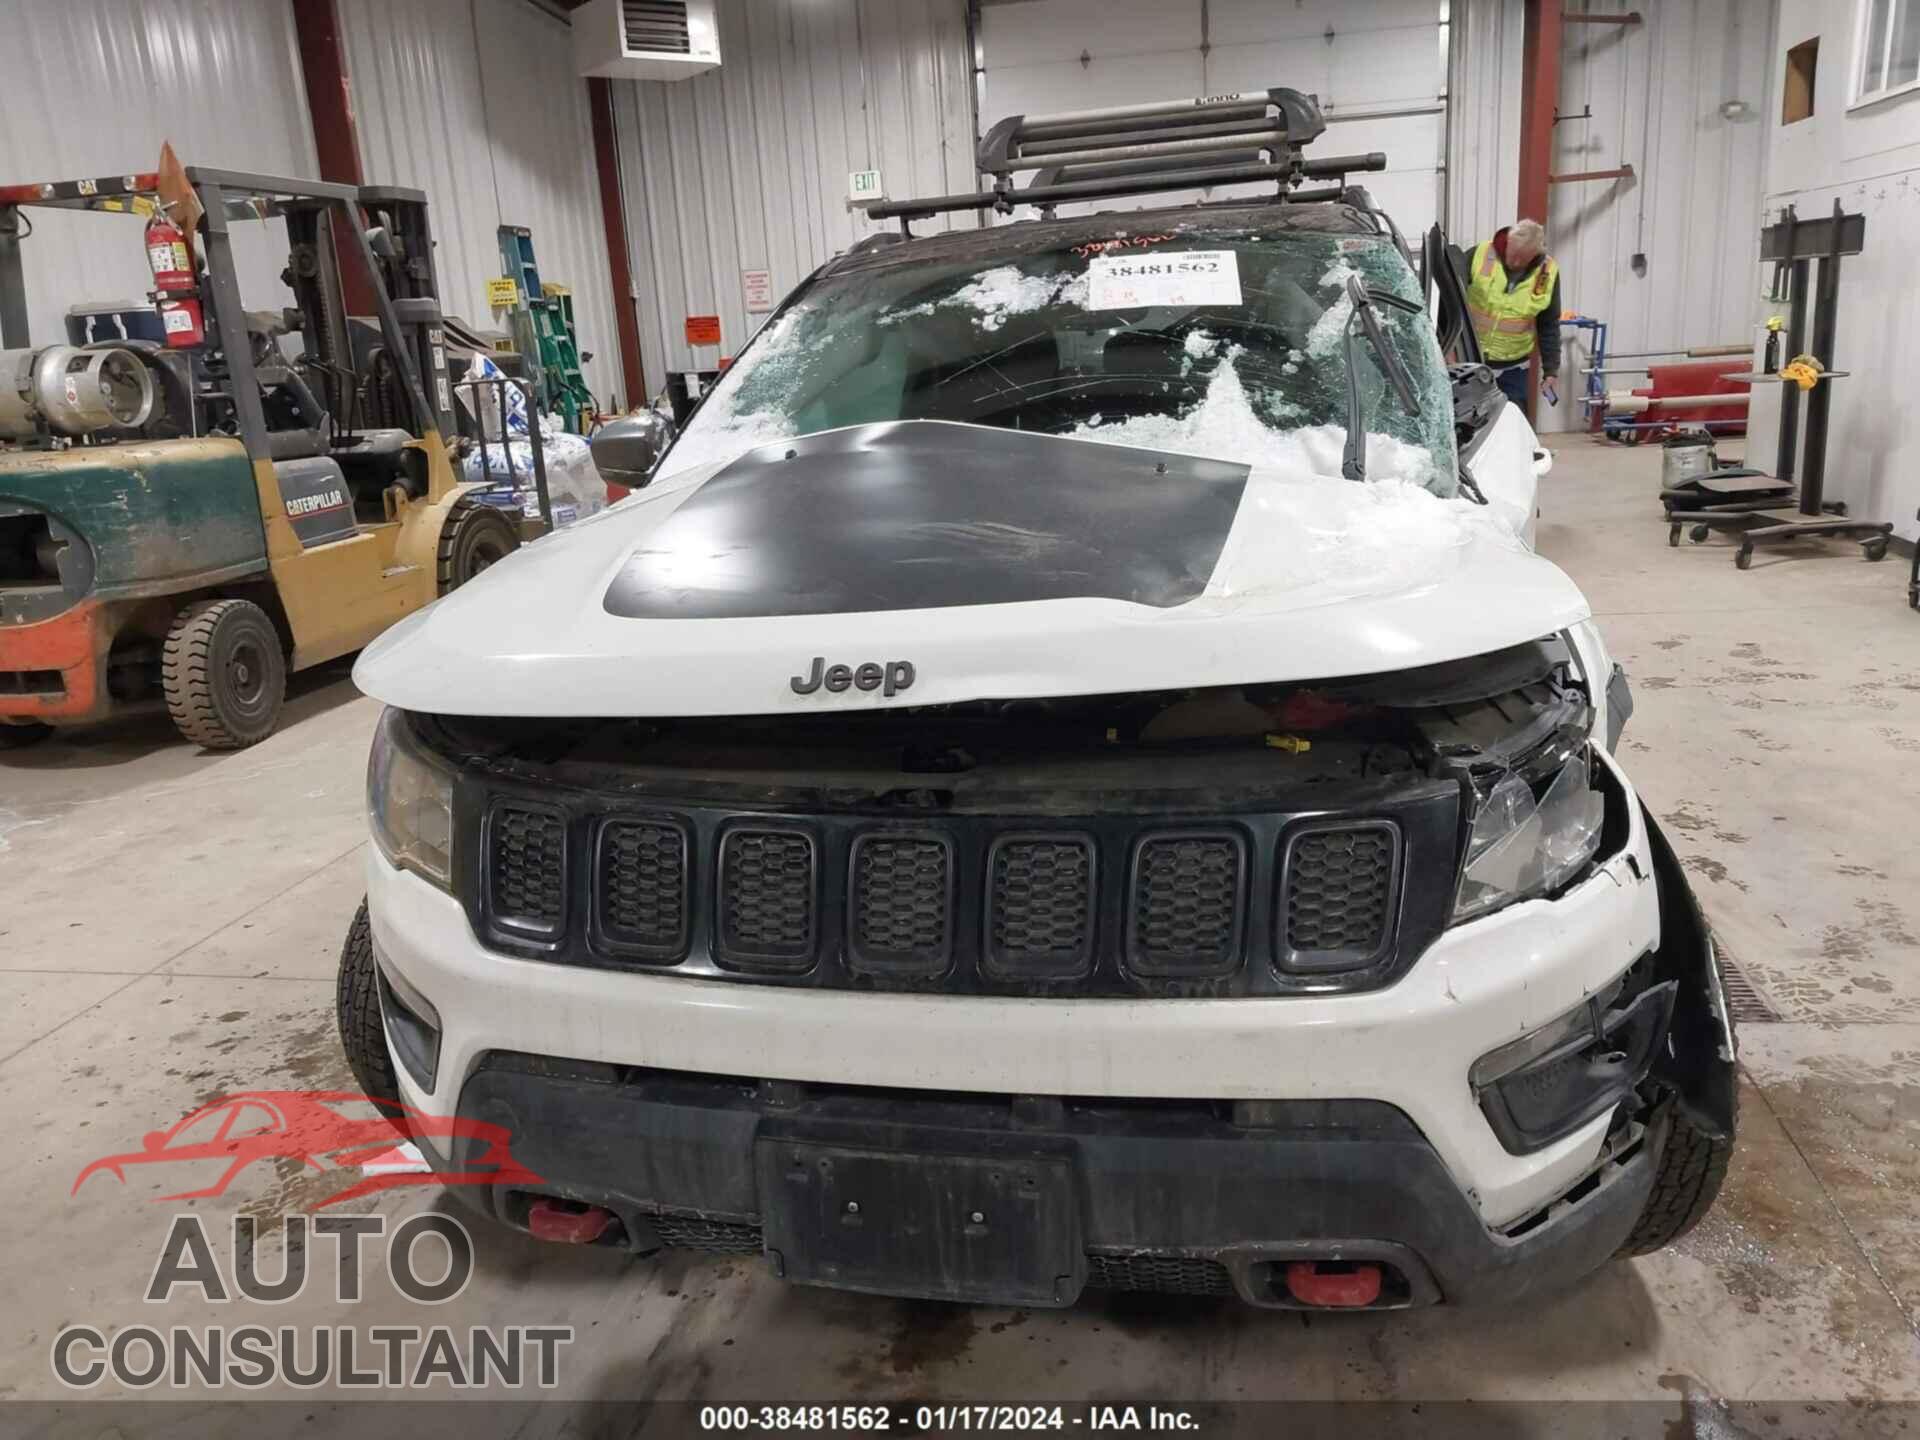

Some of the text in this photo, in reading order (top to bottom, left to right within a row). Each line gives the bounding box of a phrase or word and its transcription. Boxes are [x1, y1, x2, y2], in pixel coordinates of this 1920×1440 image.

[78, 180, 97, 195] CAT
[855, 173, 875, 191] EXIT
[1107, 262, 1220, 278] 38481562
[286, 490, 342, 515] CATERPILLAR
[791, 657, 915, 697] Jeep
